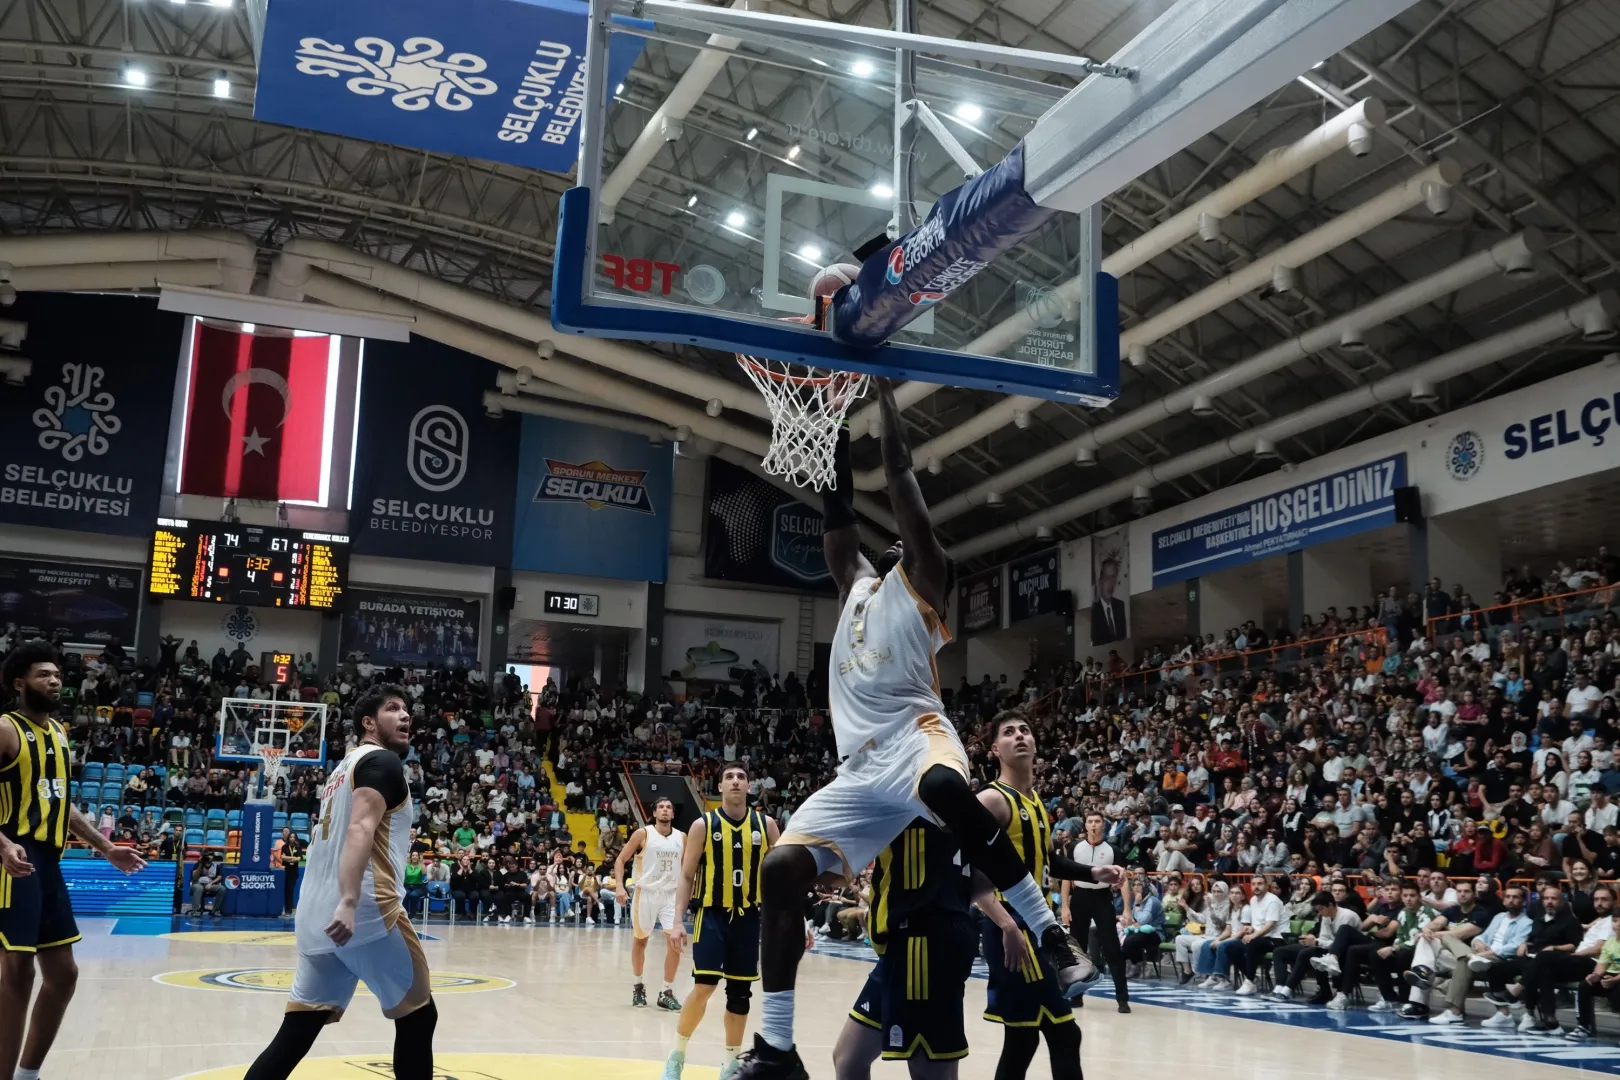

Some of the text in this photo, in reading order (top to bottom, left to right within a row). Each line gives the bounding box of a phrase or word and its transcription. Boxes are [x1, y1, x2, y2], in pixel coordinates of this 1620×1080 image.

[497, 40, 571, 143] SELÇUKLU
[4, 463, 133, 494] SELÇUKLU
[552, 467, 594, 480] SPORUN
[545, 478, 643, 504] SELÇUKLU
[0, 487, 130, 516] BELEDİYESİ
[371, 498, 494, 526] SELÇUKLU
[370, 518, 493, 540] BELEDİYESPOR
[224, 533, 239, 547] 74
[271, 538, 288, 551] 67
[246, 557, 270, 571] 1:32
[247, 571, 256, 583] 4
[360, 601, 465, 618] BURADA YETİŞİYOR
[277, 666, 287, 682] 5
[37, 778, 65, 798] 35
[660, 860, 672, 872] 33
[733, 869, 744, 887] 0
